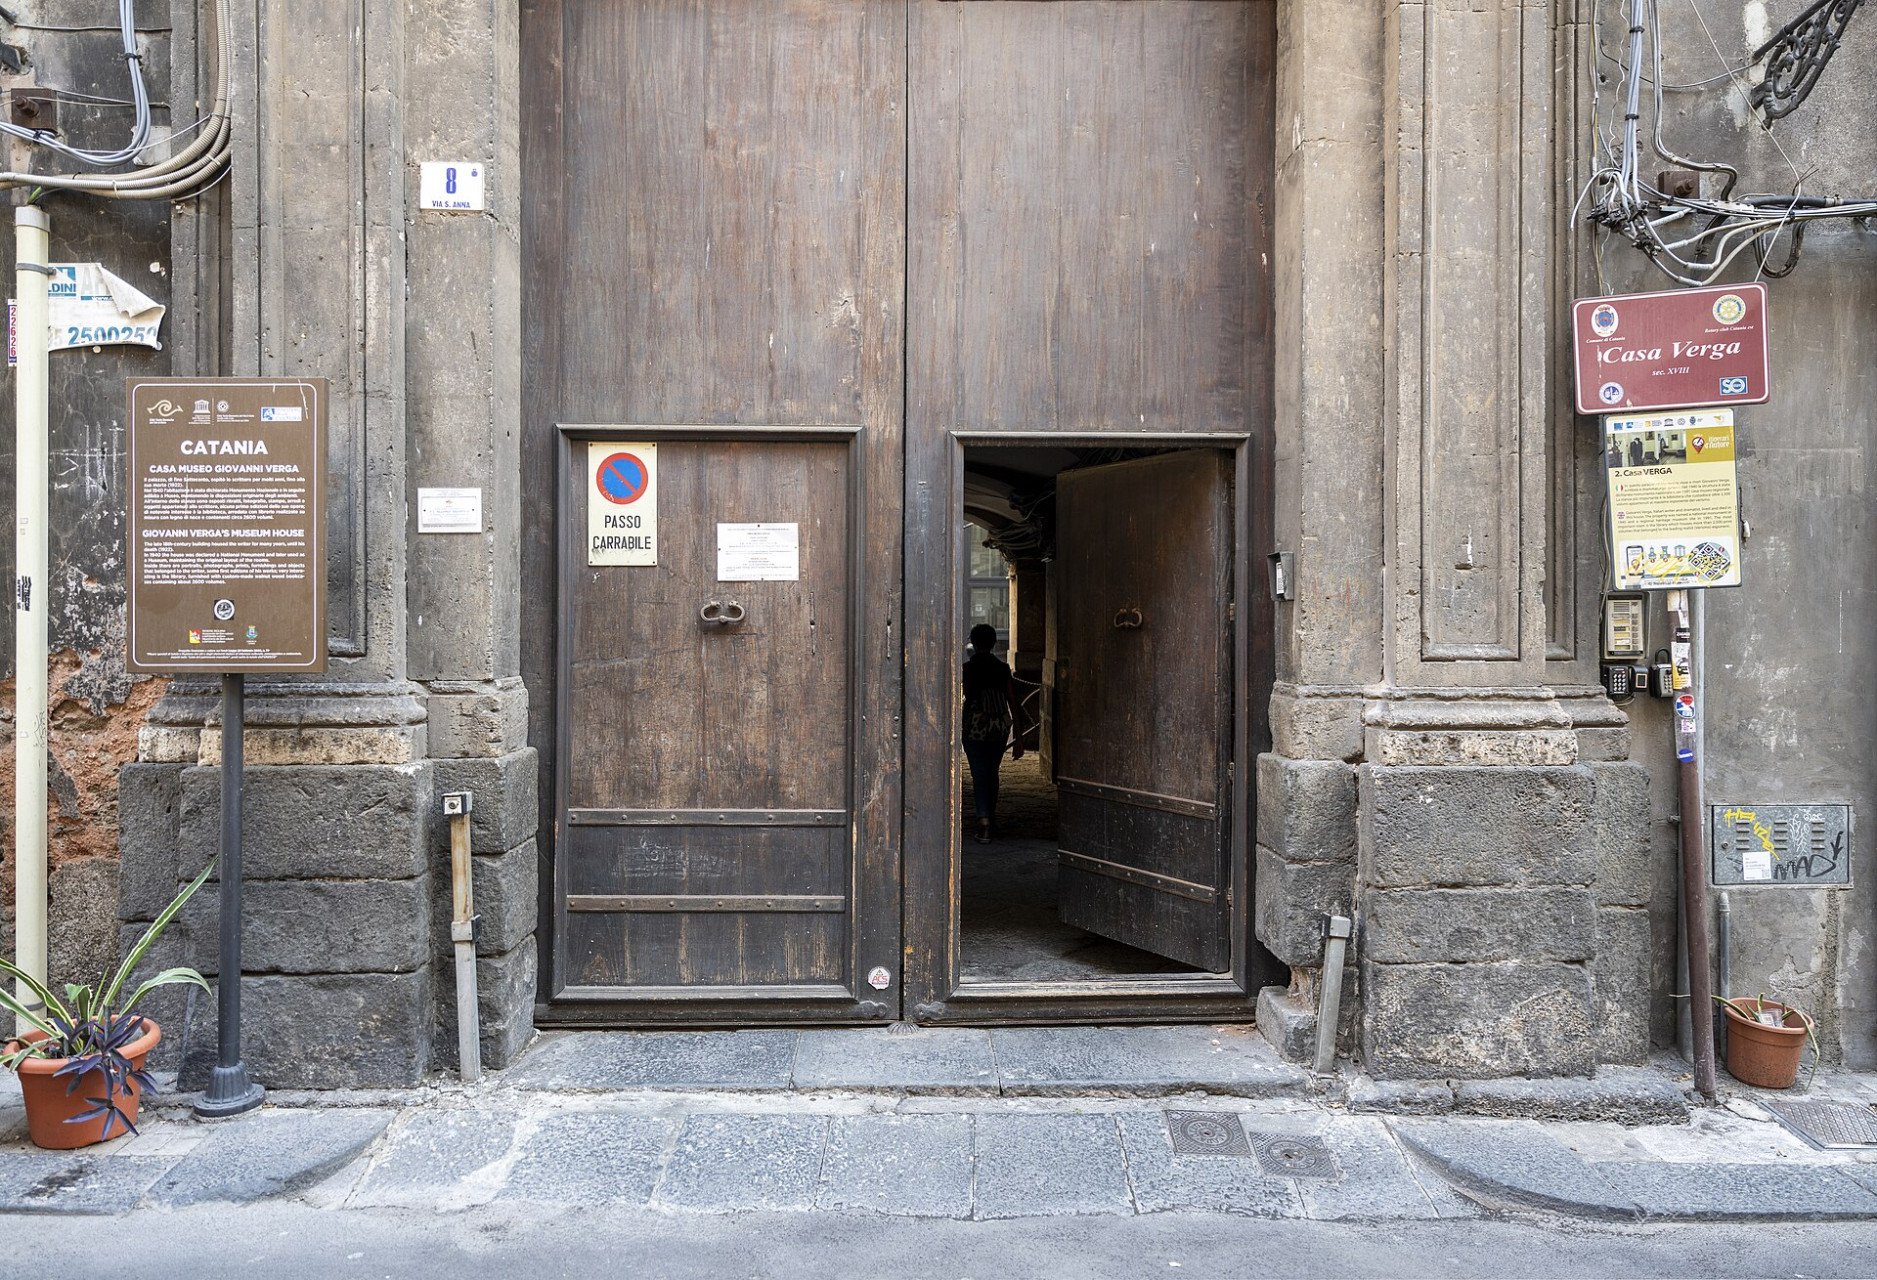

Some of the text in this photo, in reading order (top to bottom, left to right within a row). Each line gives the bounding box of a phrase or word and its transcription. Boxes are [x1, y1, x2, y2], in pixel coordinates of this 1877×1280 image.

[446, 168, 456, 194] 8
[1603, 340, 1741, 364] Casa Verga
[1667, 366, 1690, 375] XVIII
[180, 440, 268, 454] CATANIA
[149, 465, 299, 473] CASA MUSEO GIOVANNI VERGA
[1643, 467, 1672, 476] VERGA
[604, 515, 641, 528] PASSO
[142, 529, 304, 537] GIOVANNI VERGA'S MUSEUM HOUSE
[593, 536, 651, 549] CARRABILE
